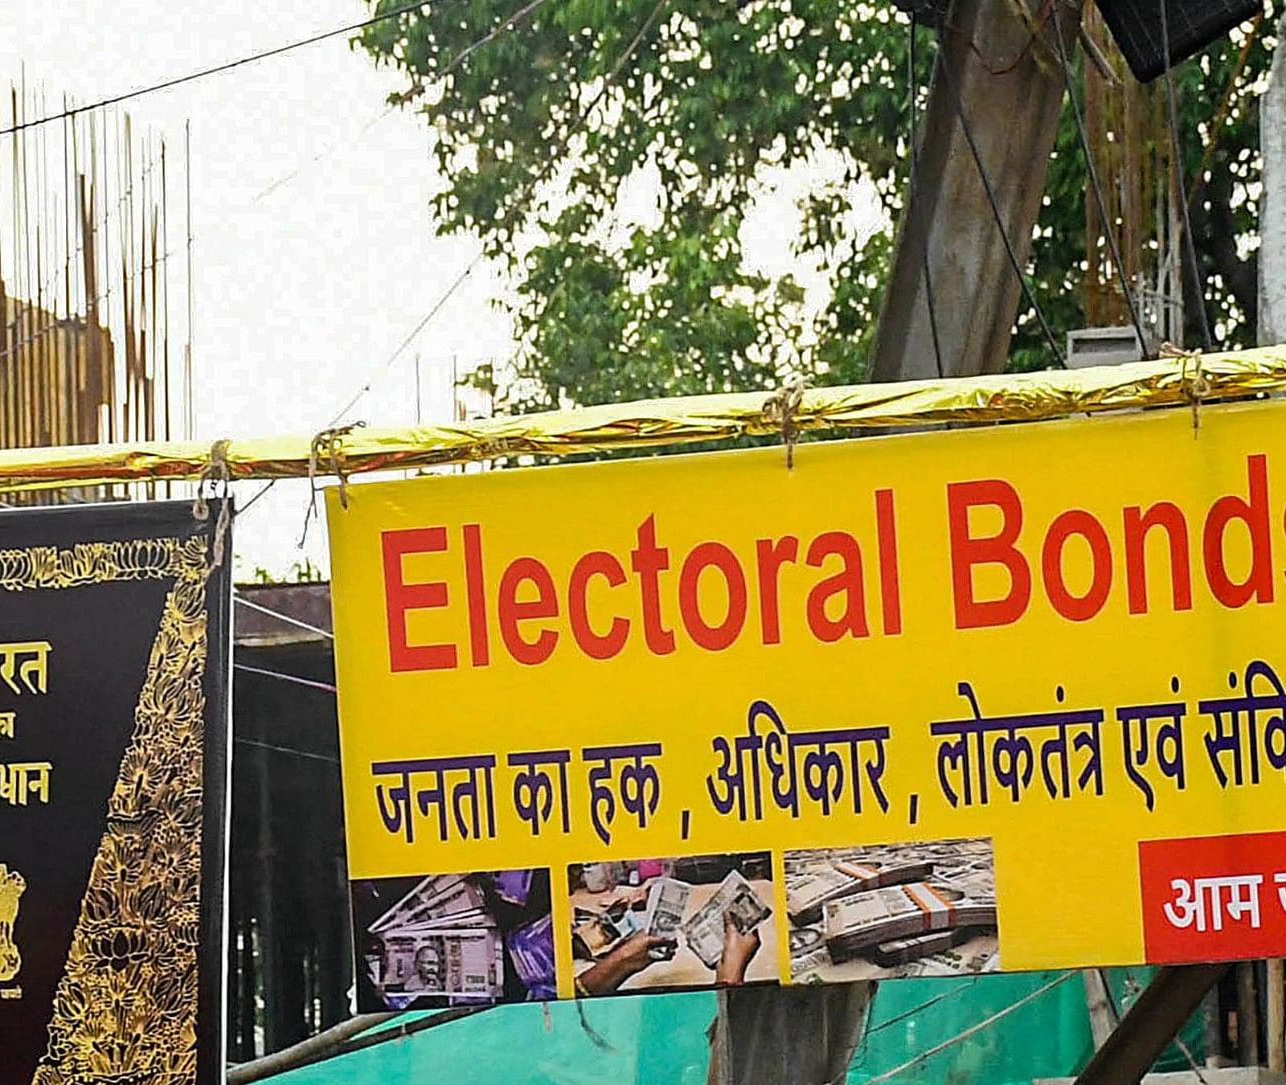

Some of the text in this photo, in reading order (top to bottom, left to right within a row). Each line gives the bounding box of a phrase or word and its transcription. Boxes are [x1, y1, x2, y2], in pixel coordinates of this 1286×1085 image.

[382, 489, 902, 673] Electoral
[371, 754, 497, 844] जनता
[507, 749, 571, 837] का
[582, 742, 663, 846] हक
[706, 700, 891, 822] अधिकार
[929, 682, 1105, 809] लोकतंत्र
[1115, 676, 1188, 814] एवं
[1163, 873, 1264, 932] आम
